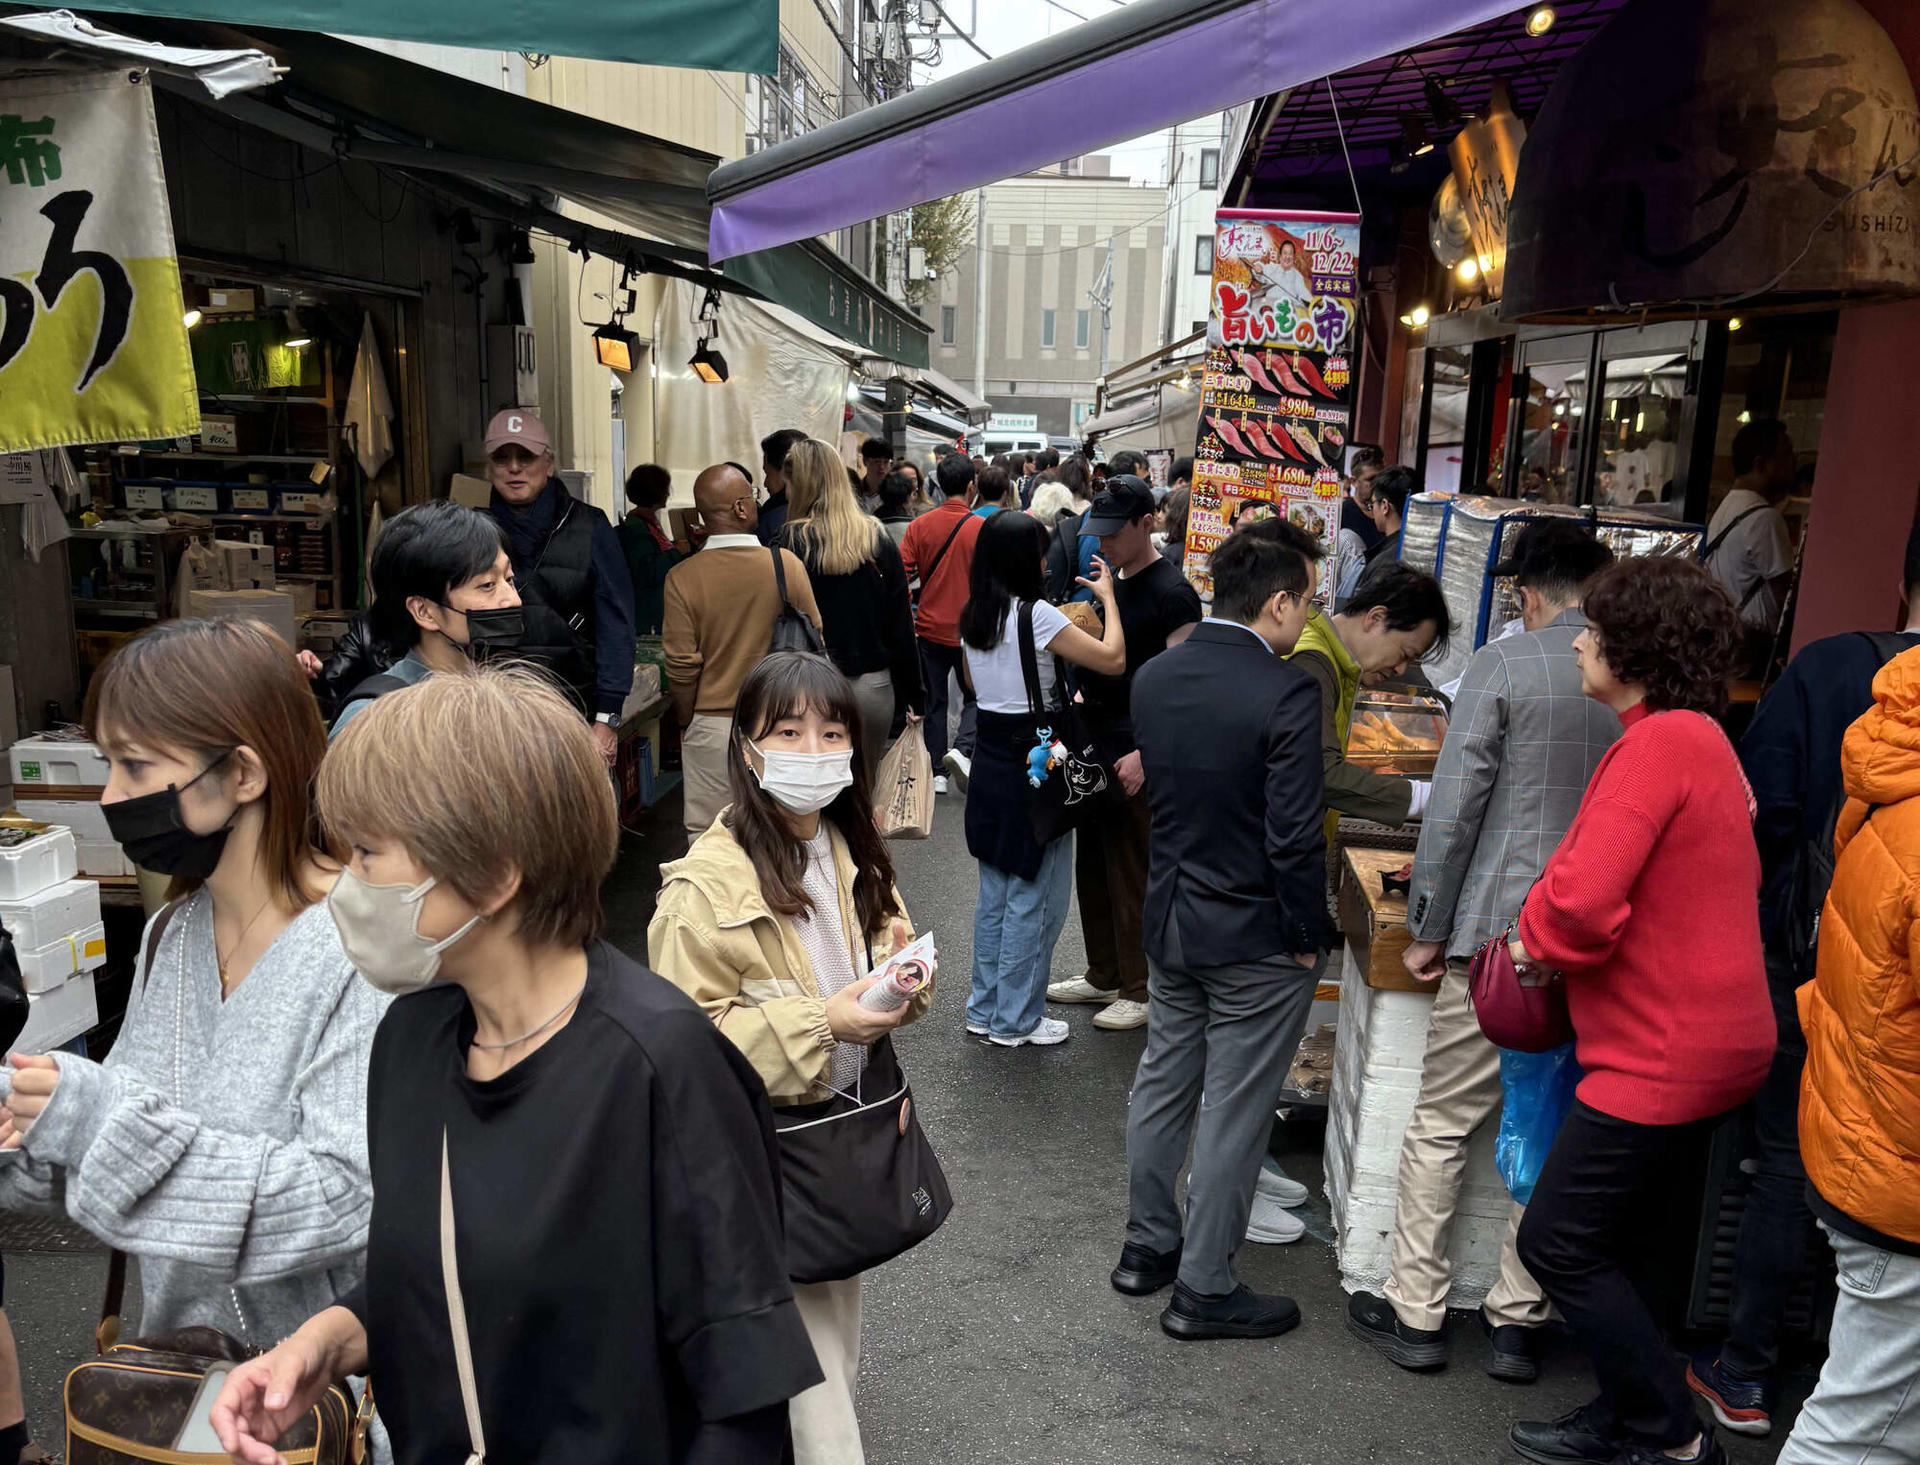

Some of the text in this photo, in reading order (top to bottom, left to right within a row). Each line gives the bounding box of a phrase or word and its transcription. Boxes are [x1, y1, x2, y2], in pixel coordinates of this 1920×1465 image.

[1315, 279, 1351, 293] 全店実施
[1217, 284, 1346, 352] 旨いもの市
[1205, 375, 1251, 391] 三貫にぎり
[507, 416, 523, 433] C
[1197, 462, 1240, 478] 五貫にぎり
[1224, 485, 1272, 500] 平日ランチ限定
[1192, 511, 1222, 525] 特製天然
